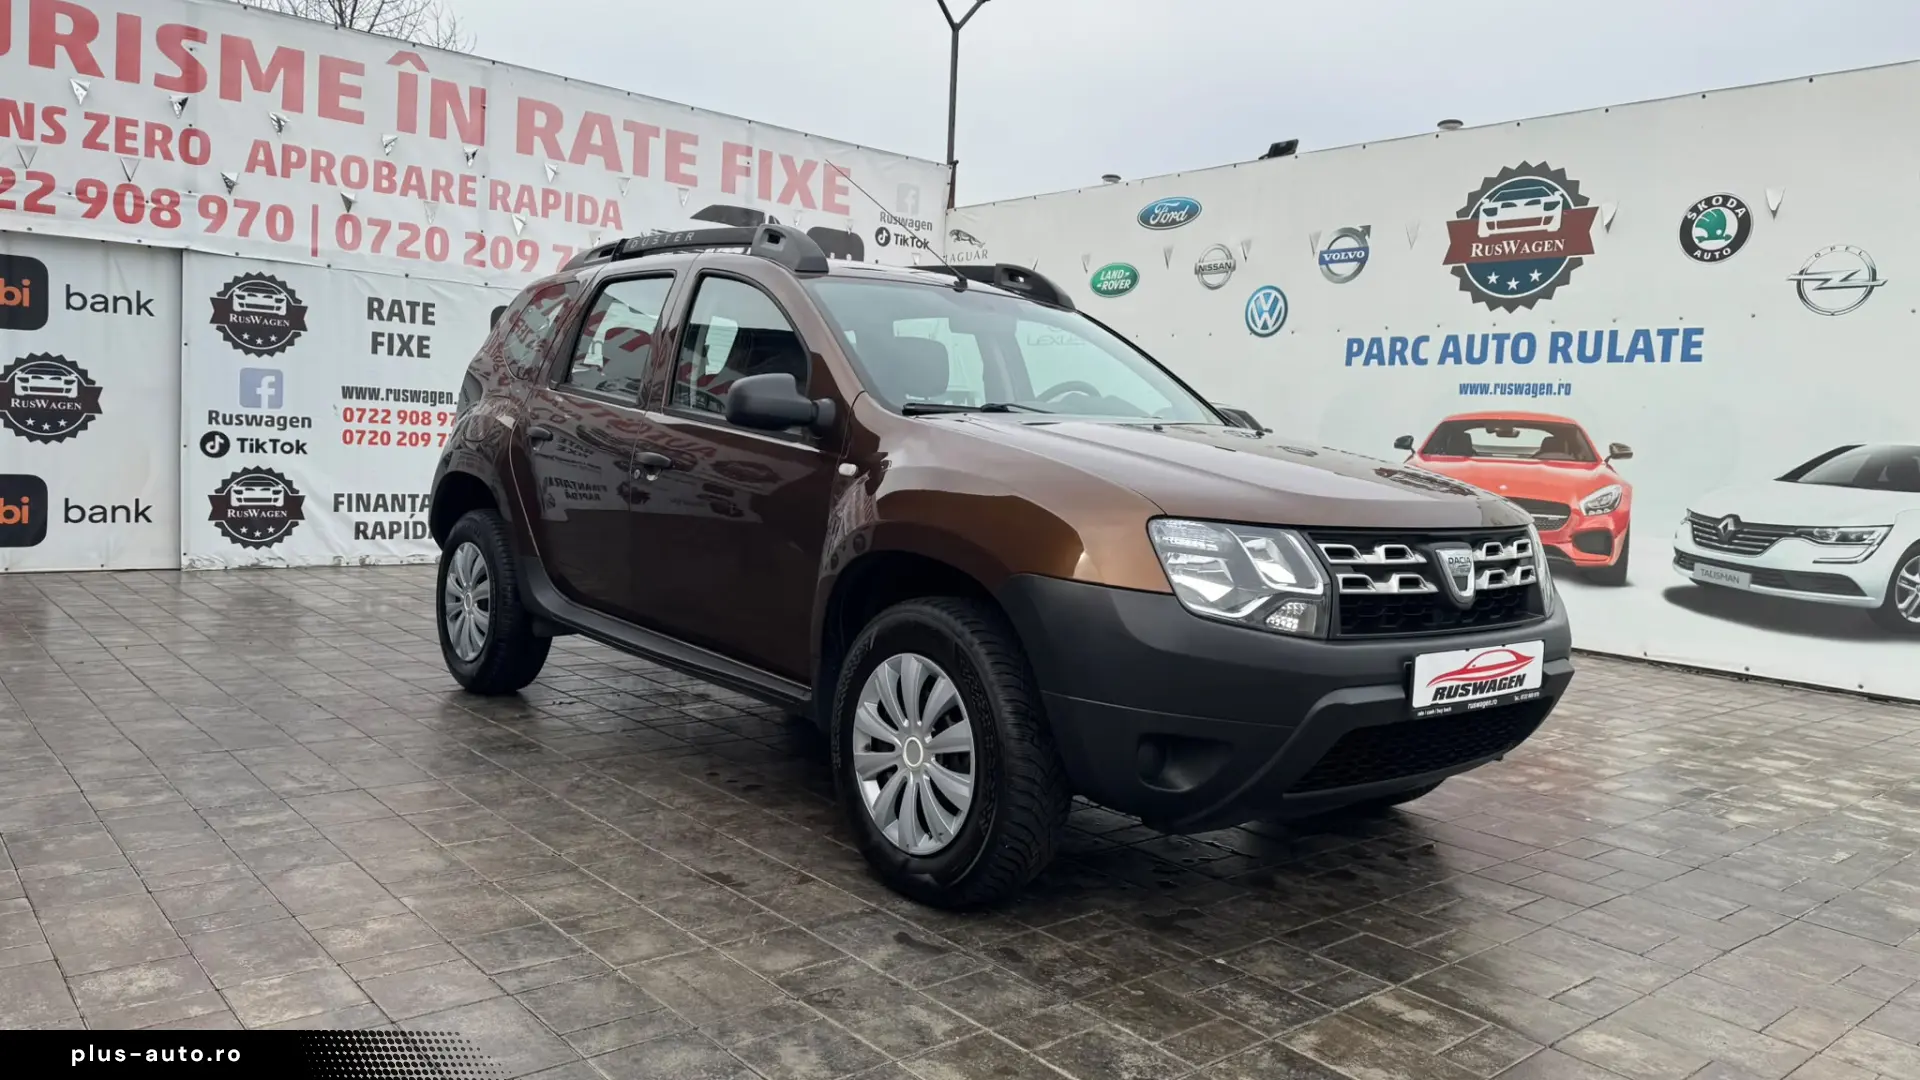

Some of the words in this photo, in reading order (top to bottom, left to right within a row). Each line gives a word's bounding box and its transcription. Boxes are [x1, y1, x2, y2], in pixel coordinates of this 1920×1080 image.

[0, 0, 366, 125] RISME
[386, 50, 487, 147] ÎN
[516, 97, 699, 188] RATE
[721, 141, 851, 216] FIXE
[82, 111, 211, 166] ZERO
[245, 139, 477, 208] APROBARE
[489, 178, 623, 231] RAPIDA
[1150, 202, 1190, 225] Ford
[1687, 195, 1747, 220] SKODA
[75, 177, 182, 229] 908
[197, 195, 294, 243] 970
[335, 213, 449, 263] 0720
[463, 231, 539, 273] 209
[552, 243, 586, 273] 7
[880, 211, 933, 232] Ruswagen
[629, 231, 696, 249] DUSTER
[893, 233, 930, 250] TikTok
[942, 249, 988, 263] JAGUAR
[1322, 250, 1366, 261] VOLVO
[1693, 247, 1731, 260] AUTO
[1814, 246, 1864, 258] OPEL
[1100, 269, 1125, 281] LAND
[1198, 262, 1232, 272] NISSAN
[1101, 279, 1131, 291] ROVER
[65, 283, 156, 318] bank
[366, 296, 436, 326] RATE
[370, 331, 431, 359] FIXE
[1344, 334, 1431, 367] PARC
[1437, 331, 1537, 366] AUTO
[1548, 327, 1705, 364] RULATE
[1459, 382, 1572, 398] www.ruswagen.ro
[207, 409, 312, 431] Ruswagen
[342, 407, 392, 425] 0722
[396, 409, 432, 426] 908
[237, 437, 308, 455] TikTok
[342, 429, 392, 446] 0720
[396, 431, 432, 447] 209
[437, 433, 453, 448] 7
[63, 498, 153, 524] bank
[1448, 556, 1471, 565] DACIA
[1700, 568, 1740, 585] TALISMAN
[1431, 673, 1526, 702] RUSWAGEN
